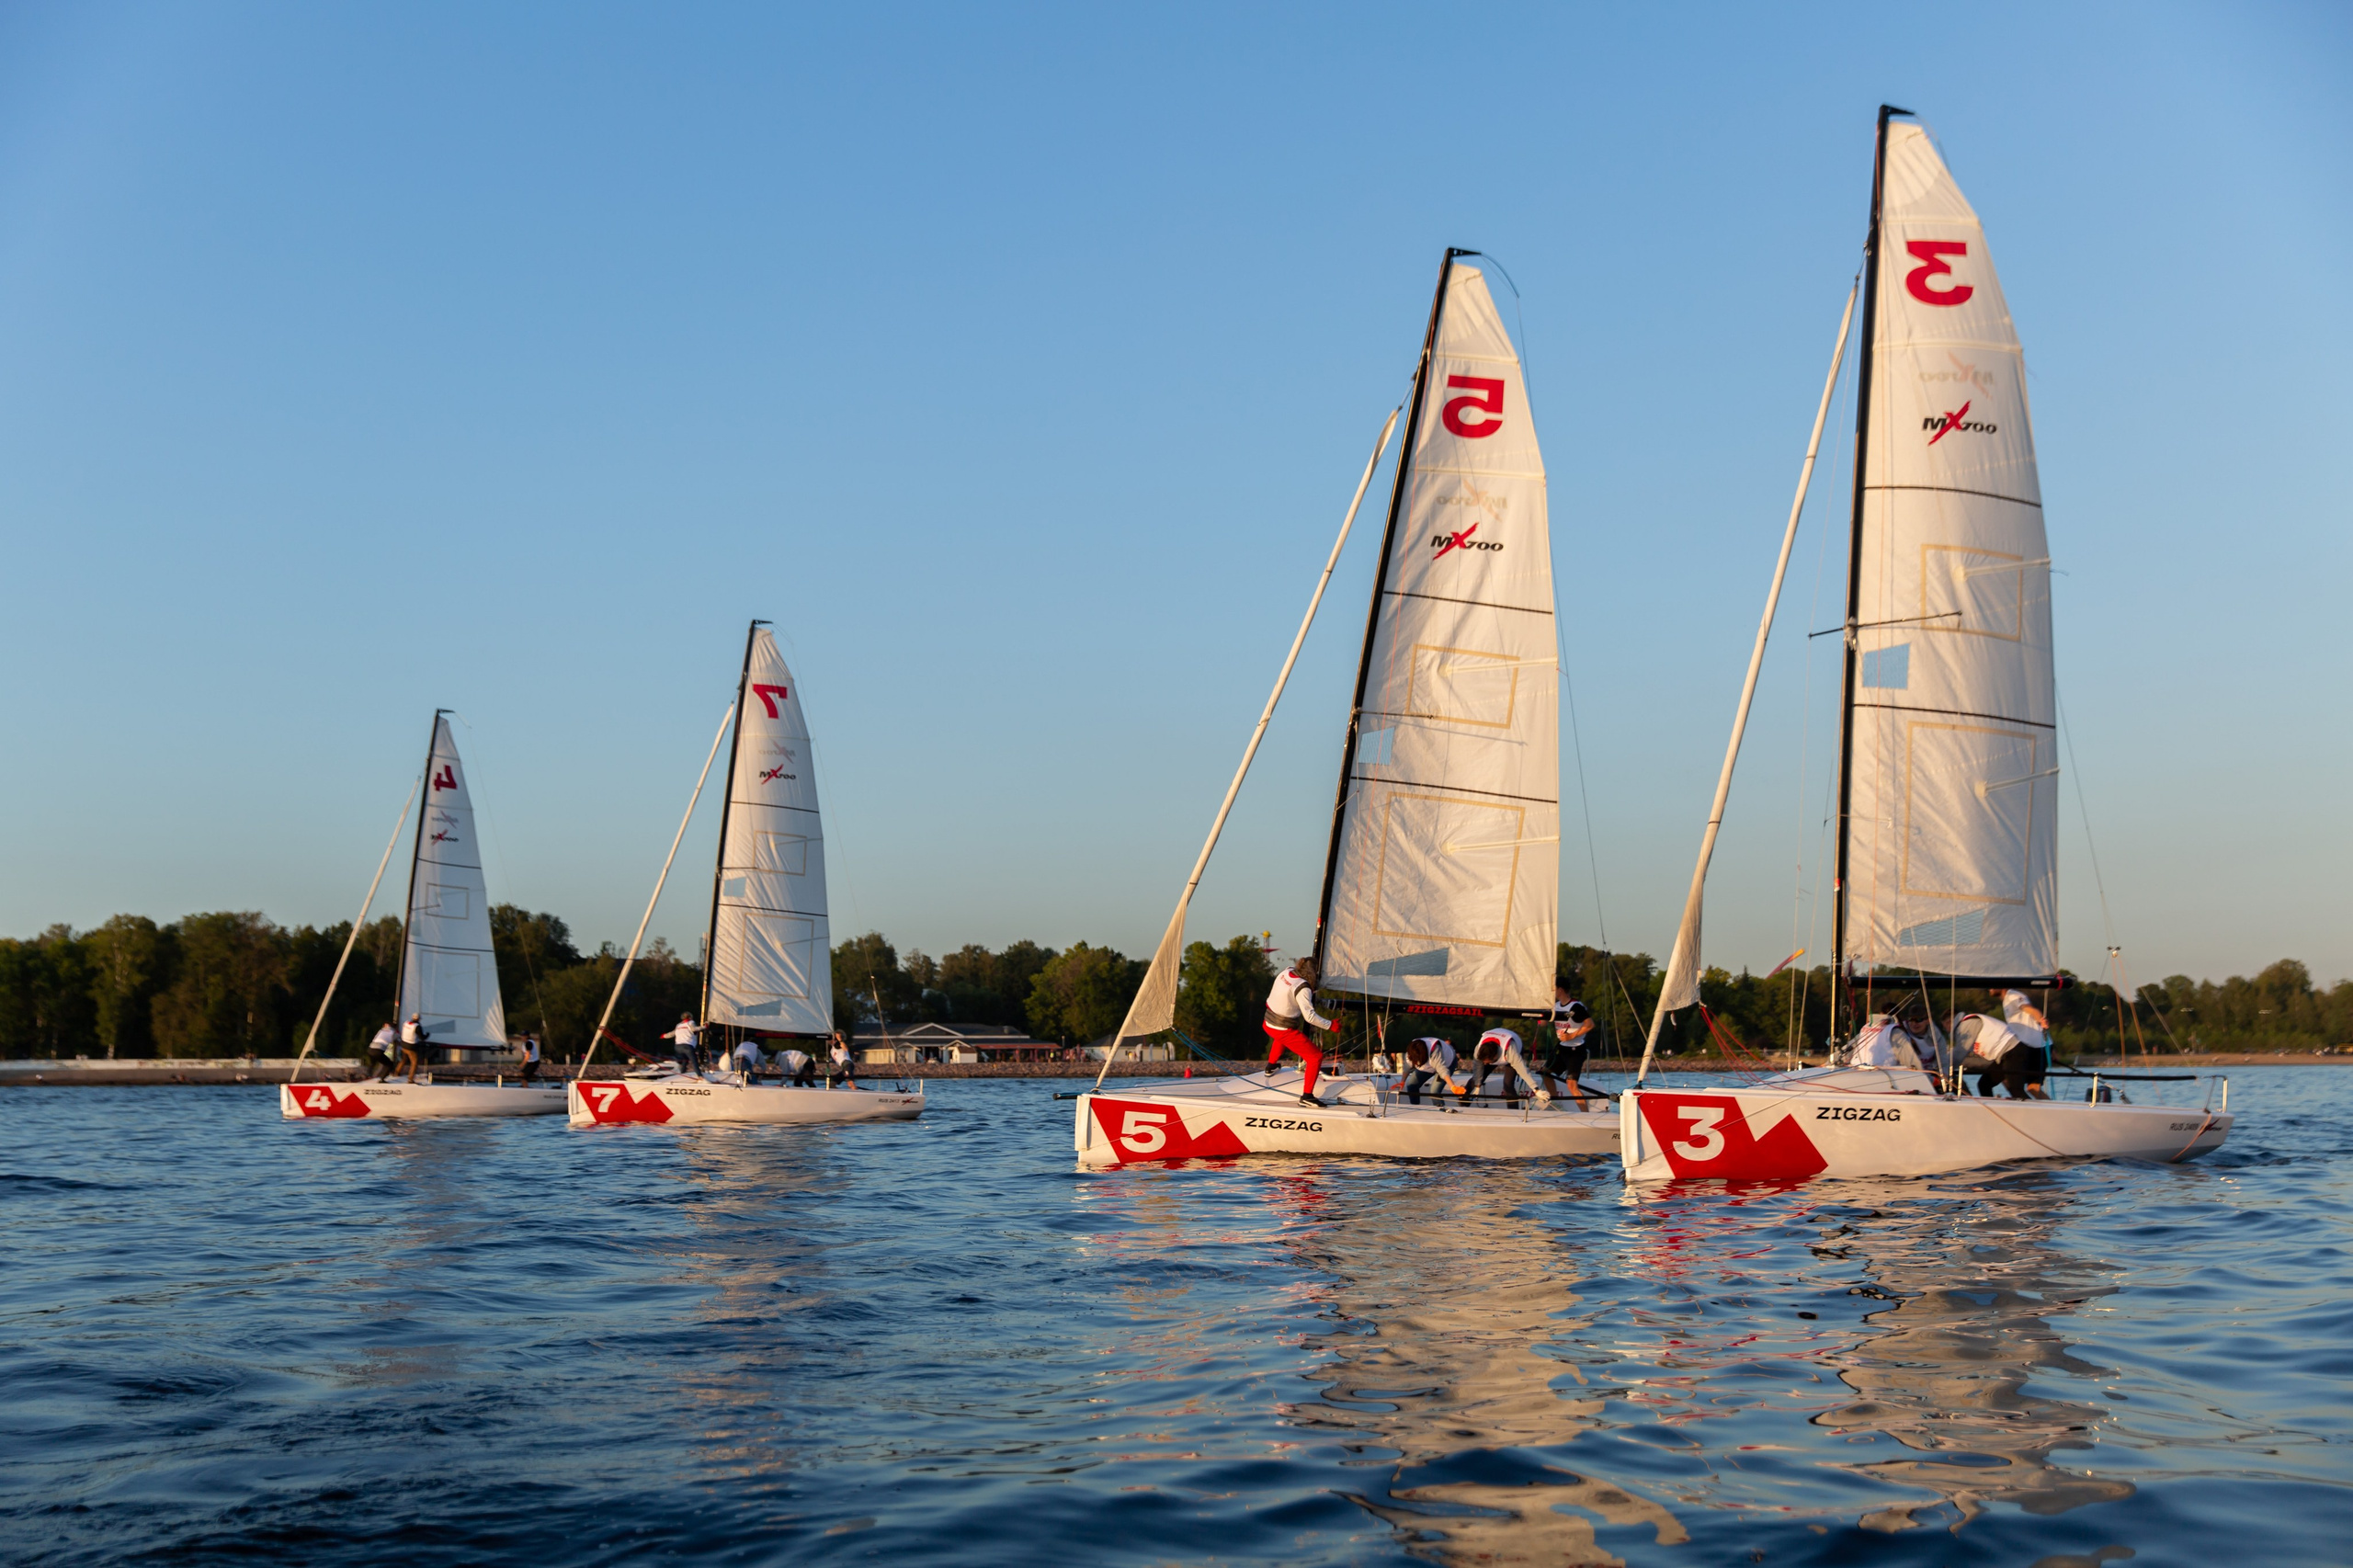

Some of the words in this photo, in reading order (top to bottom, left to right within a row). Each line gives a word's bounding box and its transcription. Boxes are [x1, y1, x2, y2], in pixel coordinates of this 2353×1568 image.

[1922, 400, 1997, 447] MX700
[1430, 521, 1504, 561] MX700
[1406, 1005, 1484, 1017] #ZIGZAGSAIL
[304, 1089, 332, 1111] 4
[591, 1086, 621, 1113] 7
[665, 1087, 711, 1096] ZIGZAG
[1245, 1117, 1324, 1132] ZIGZAG
[1816, 1107, 1901, 1122] ZIGZAG
[1120, 1110, 1167, 1153] 5
[1672, 1106, 1725, 1162] 3
